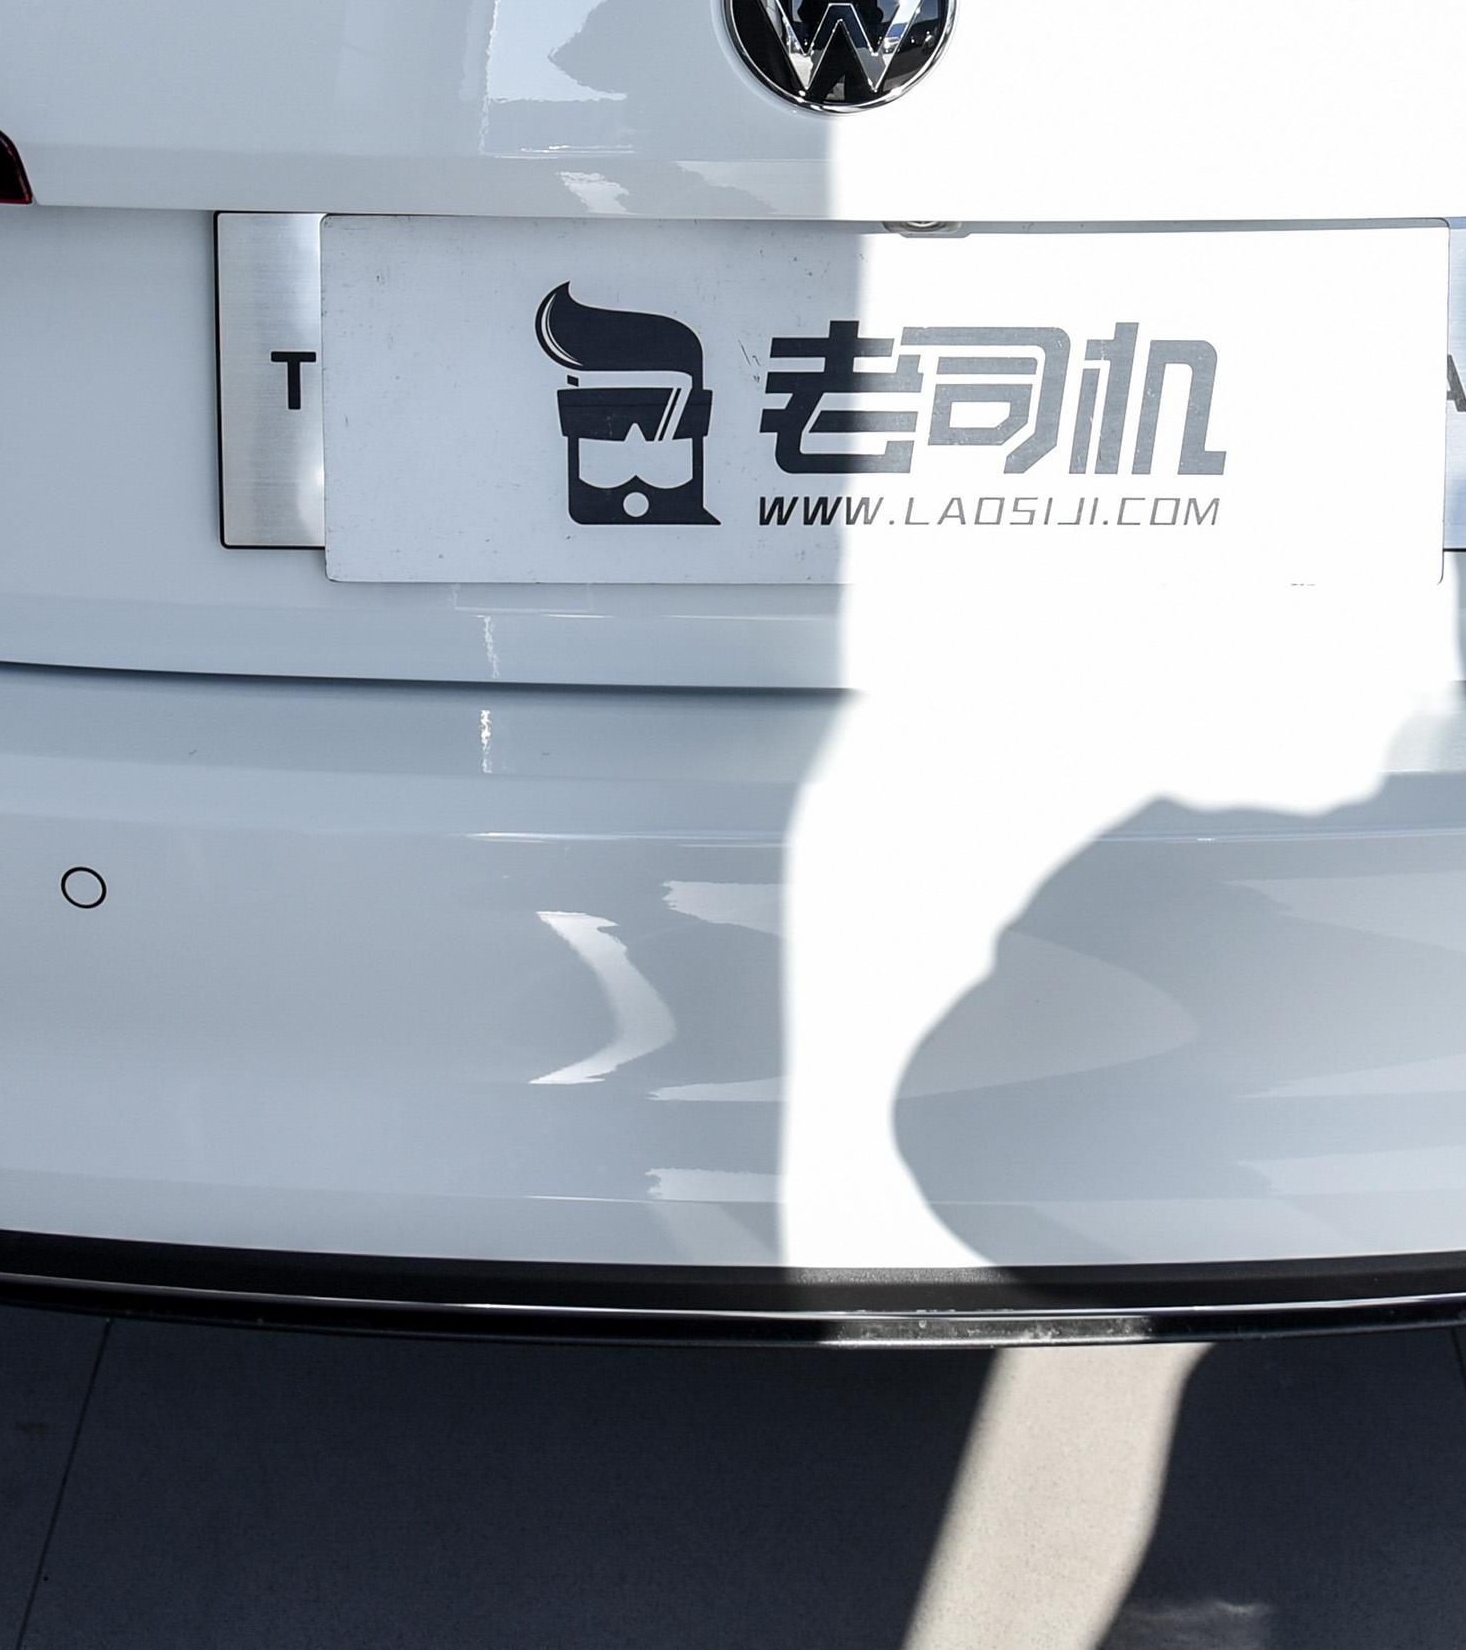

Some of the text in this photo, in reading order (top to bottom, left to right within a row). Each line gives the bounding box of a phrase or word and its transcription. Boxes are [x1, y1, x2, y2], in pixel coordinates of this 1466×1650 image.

[759, 320, 1227, 476] 老司机
[758, 496, 1221, 526] WWW.LAOSIJI.COM
